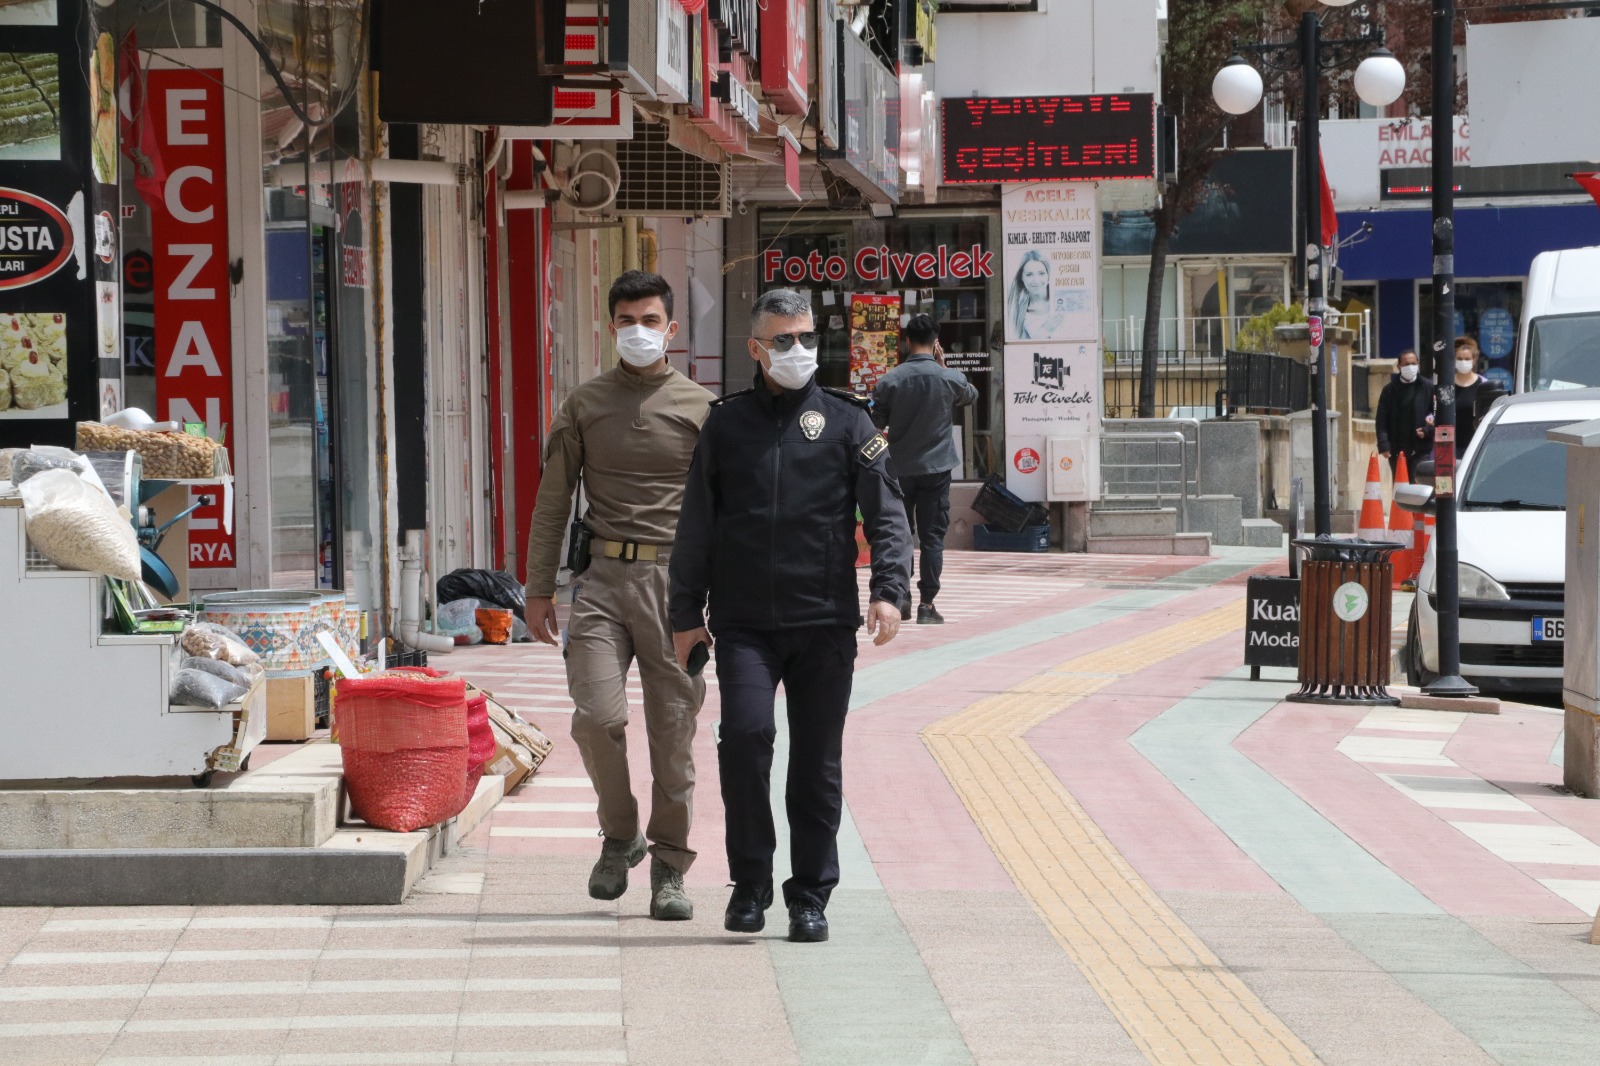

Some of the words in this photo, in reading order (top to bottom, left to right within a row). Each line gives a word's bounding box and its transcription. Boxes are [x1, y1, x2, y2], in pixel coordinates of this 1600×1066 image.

[1378, 124, 1433, 142] EMLA
[956, 138, 1138, 173] ÇEŞİTLERİ
[1023, 189, 1076, 203] ACELE
[0, 202, 19, 214] PLİ
[1060, 230, 1091, 243] PASAPORT
[763, 249, 847, 282] Foto
[854, 243, 995, 282] Civelek
[1013, 391, 1038, 404] Foto
[1041, 391, 1093, 404] Civelek
[189, 543, 233, 562] RYA
[1252, 599, 1301, 620] Kua
[1545, 620, 1565, 638] 66
[1249, 630, 1300, 648] Moda
